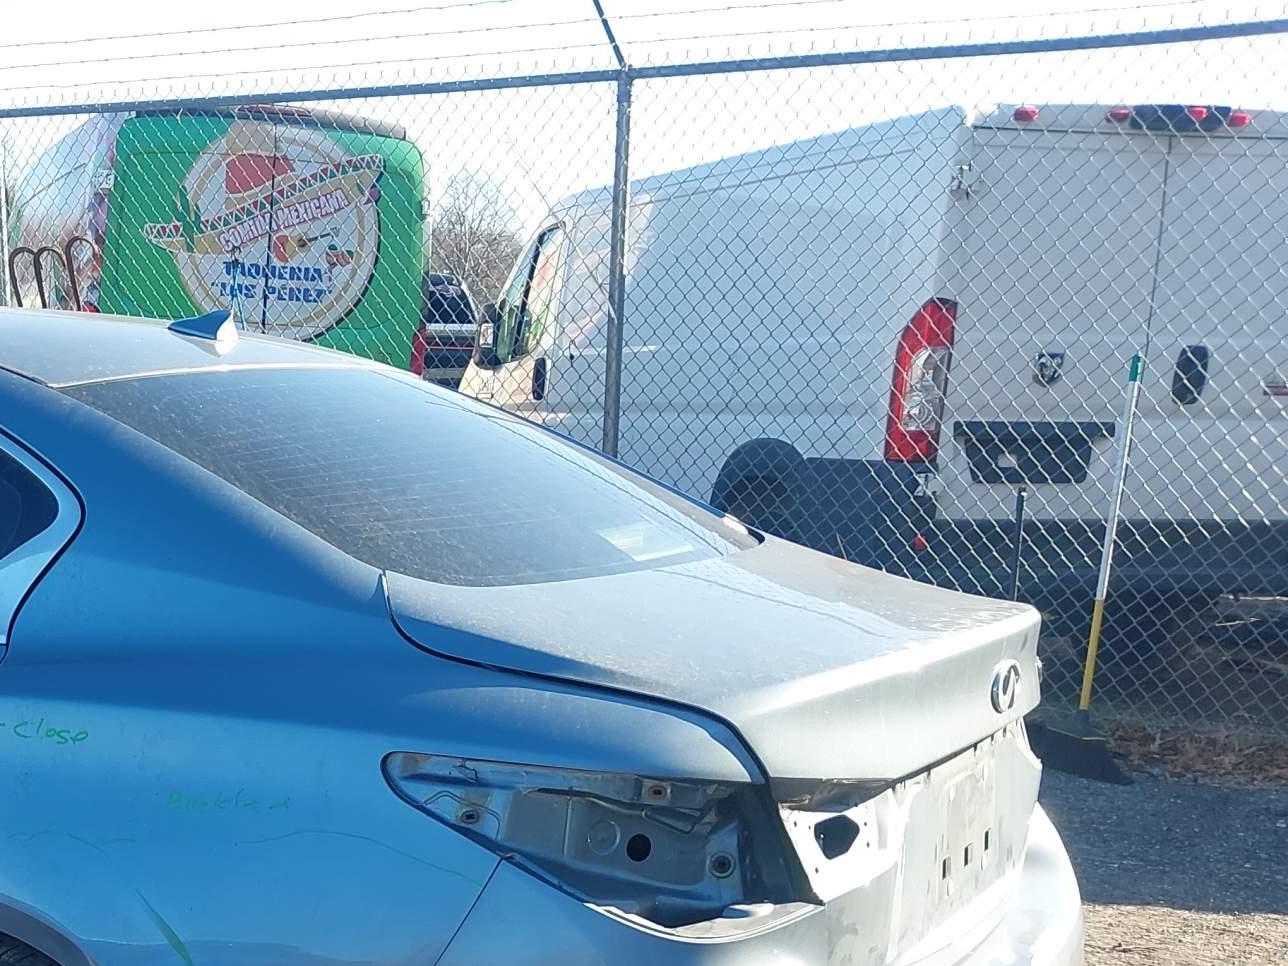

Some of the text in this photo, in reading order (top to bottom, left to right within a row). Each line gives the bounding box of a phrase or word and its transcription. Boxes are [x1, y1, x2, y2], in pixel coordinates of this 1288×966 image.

[218, 187, 351, 253] COMIDA MEXICANA
[222, 261, 324, 282] TAQUERIA
